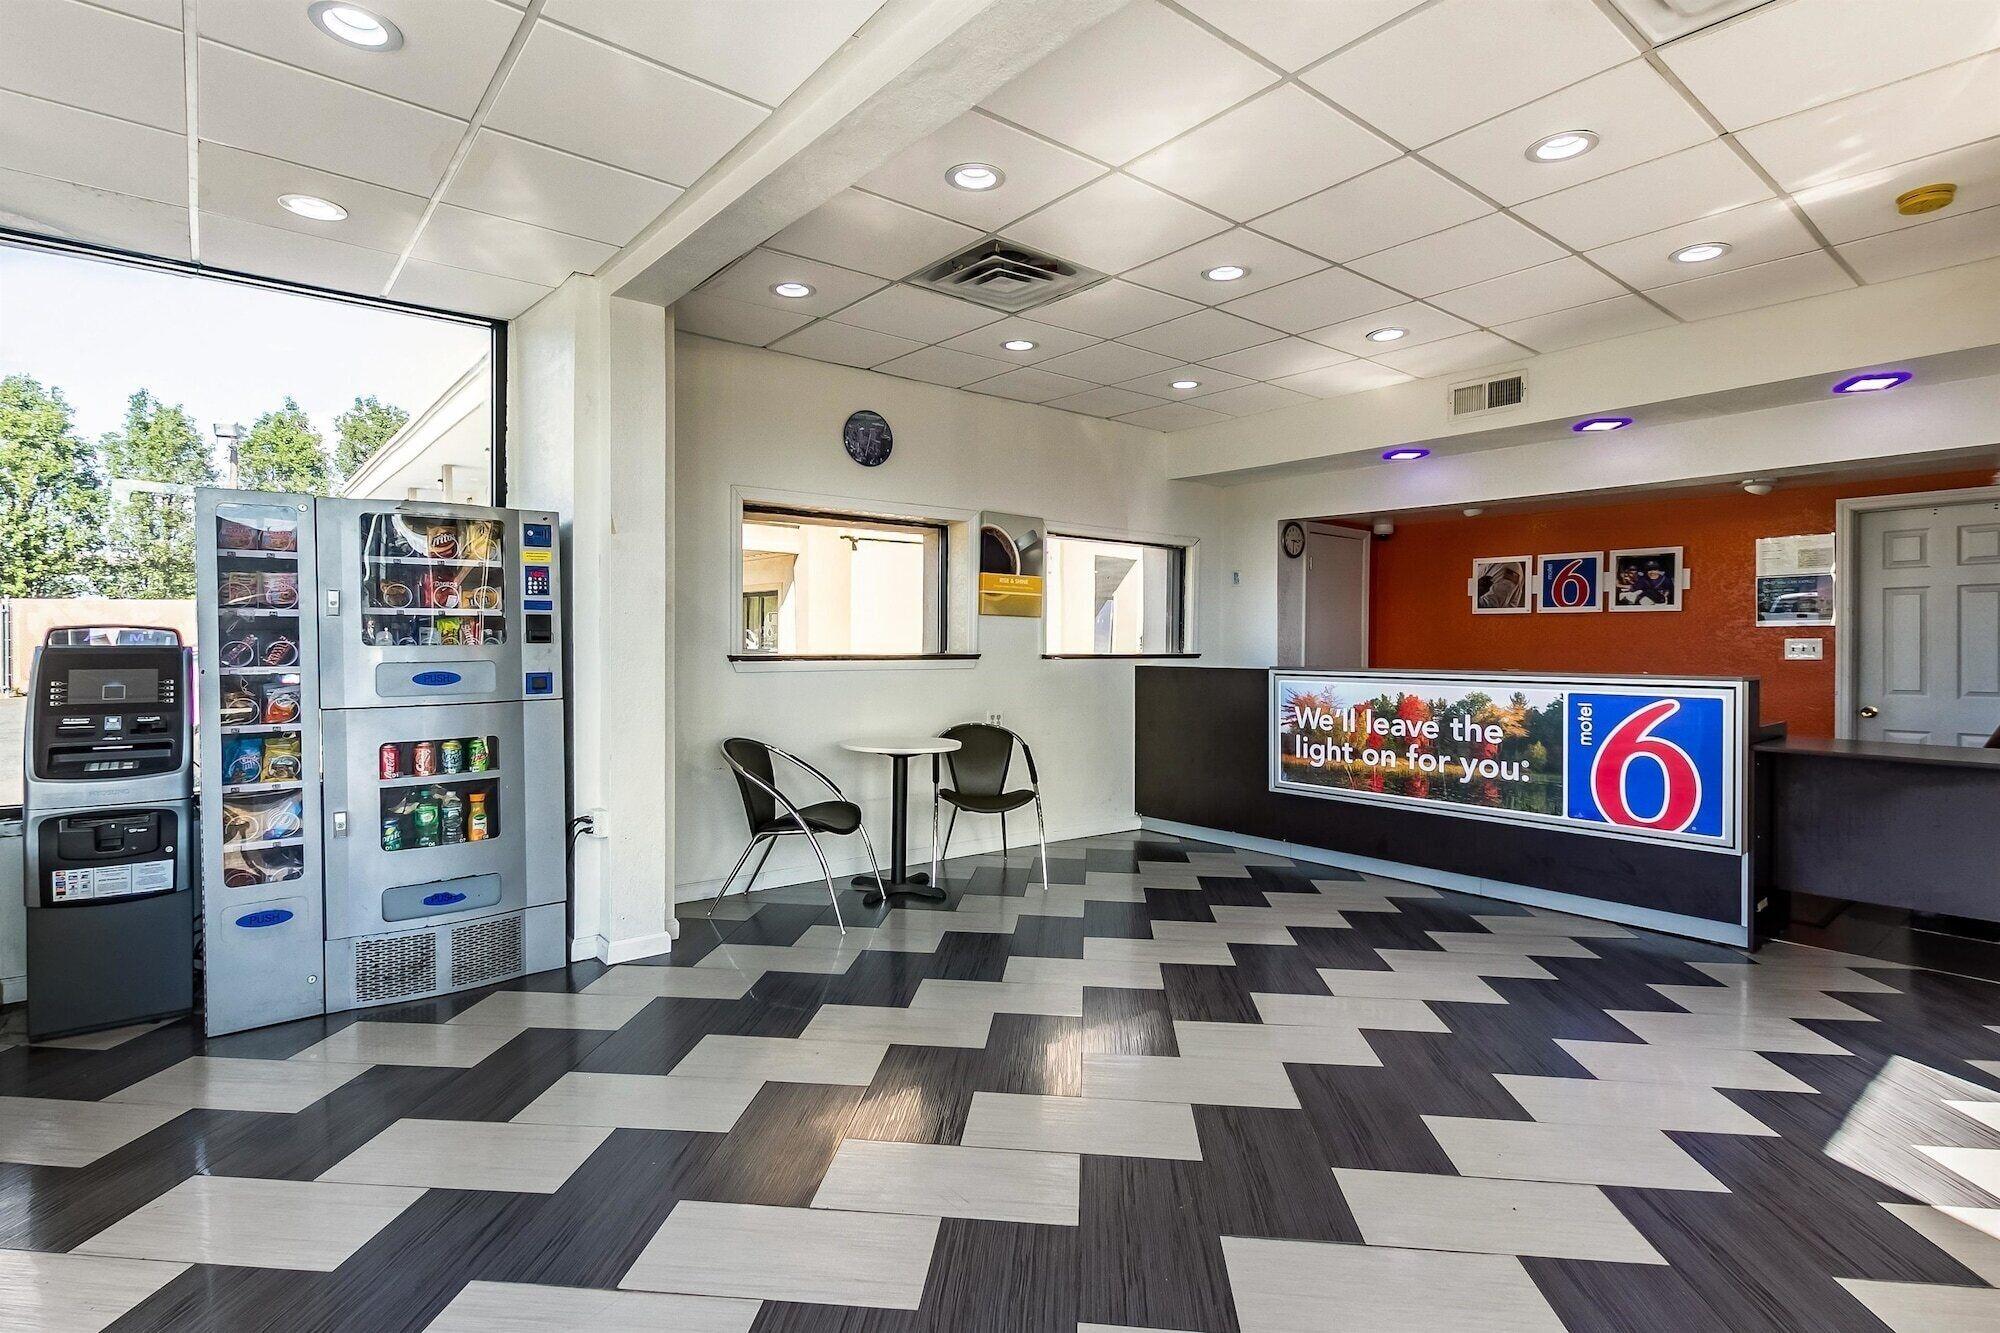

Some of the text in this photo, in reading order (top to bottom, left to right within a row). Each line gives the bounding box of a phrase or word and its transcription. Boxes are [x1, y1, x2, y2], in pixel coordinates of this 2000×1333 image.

[1551, 559, 1590, 608] 6
[424, 674, 450, 683] PUSH
[1295, 706, 1504, 744] We'll leave the
[1577, 702, 1593, 746] motel
[1295, 734, 1354, 767] light
[1362, 748, 1397, 768] on
[1406, 744, 1451, 773] for
[1590, 699, 1702, 833] 6
[249, 911, 281, 926] PUSH
